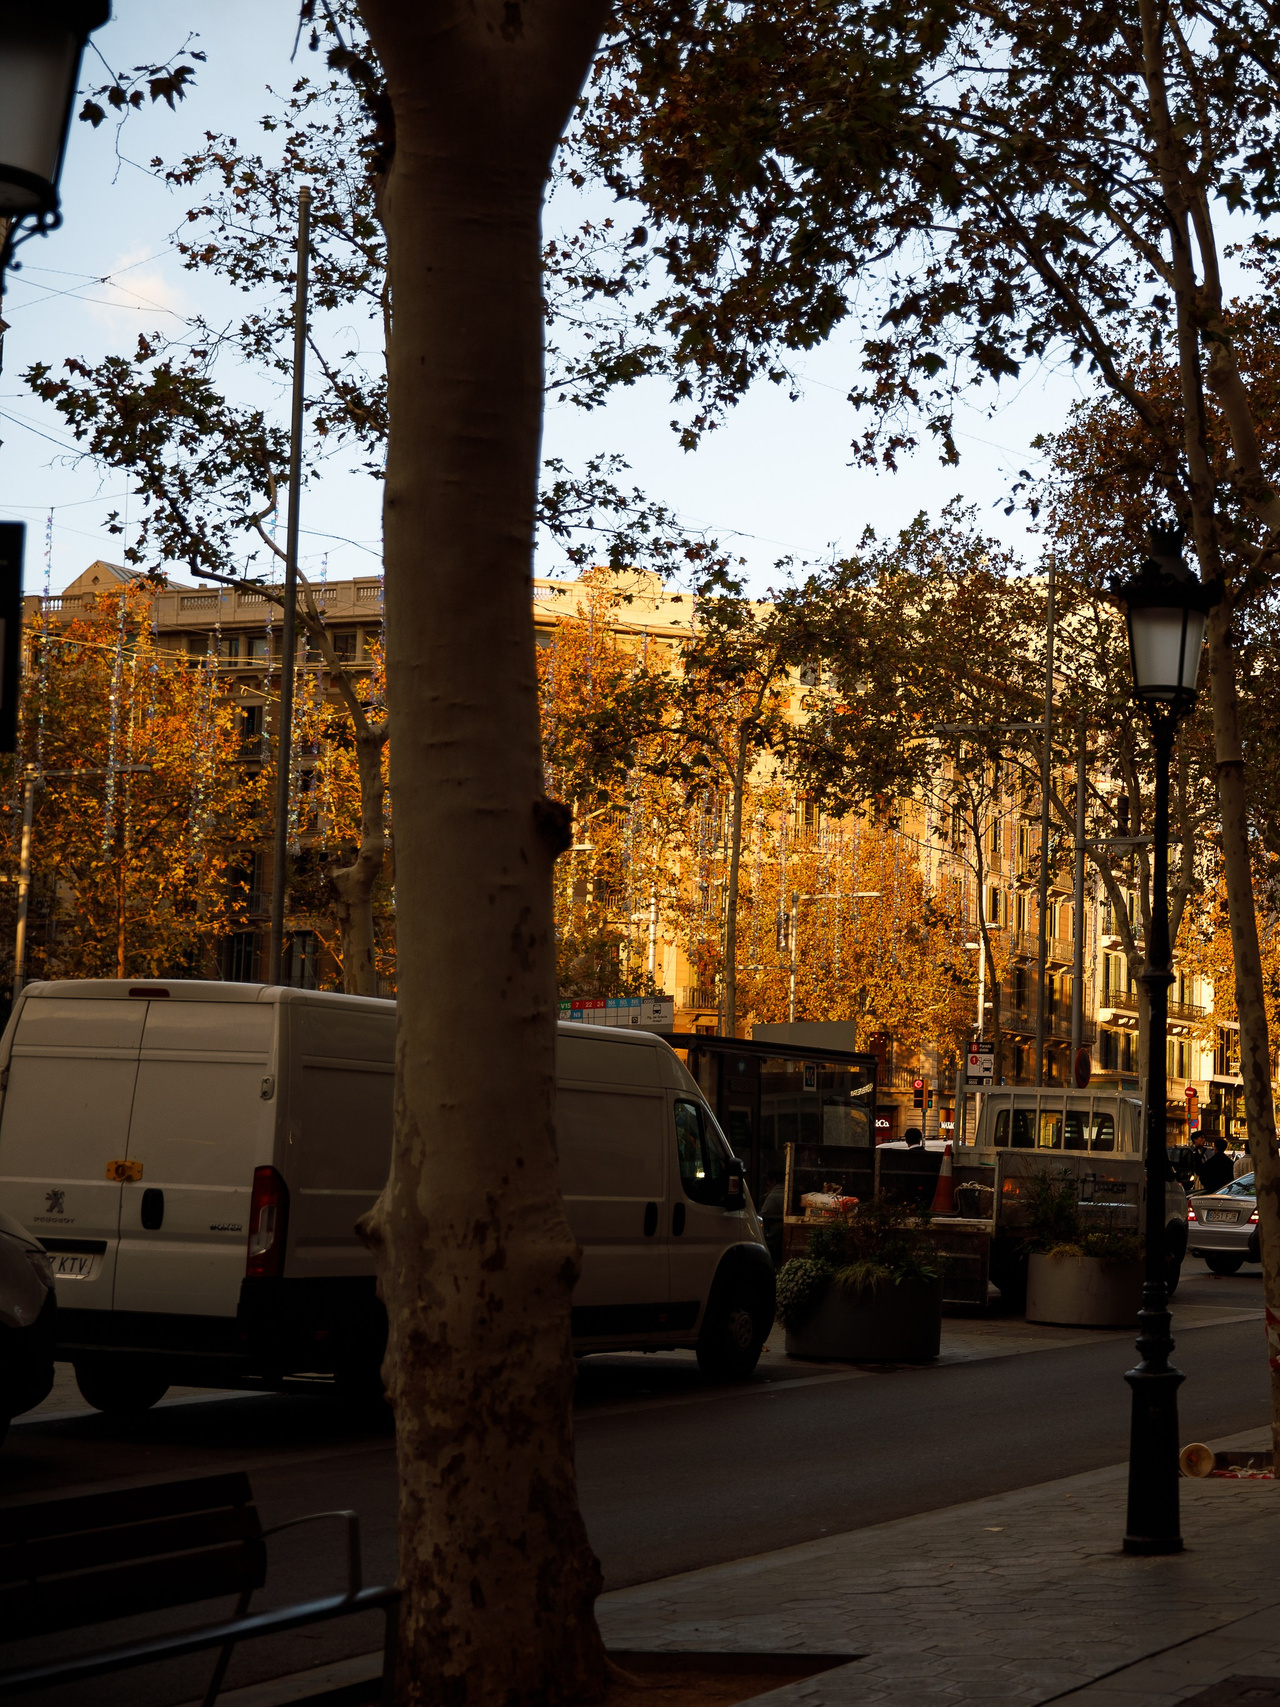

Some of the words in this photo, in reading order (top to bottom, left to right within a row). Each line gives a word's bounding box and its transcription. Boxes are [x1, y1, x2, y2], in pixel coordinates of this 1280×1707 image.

[34, 1216, 75, 1224] PEUGEOT
[209, 1222, 242, 1232] BOXER
[58, 1257, 88, 1273] KTV
